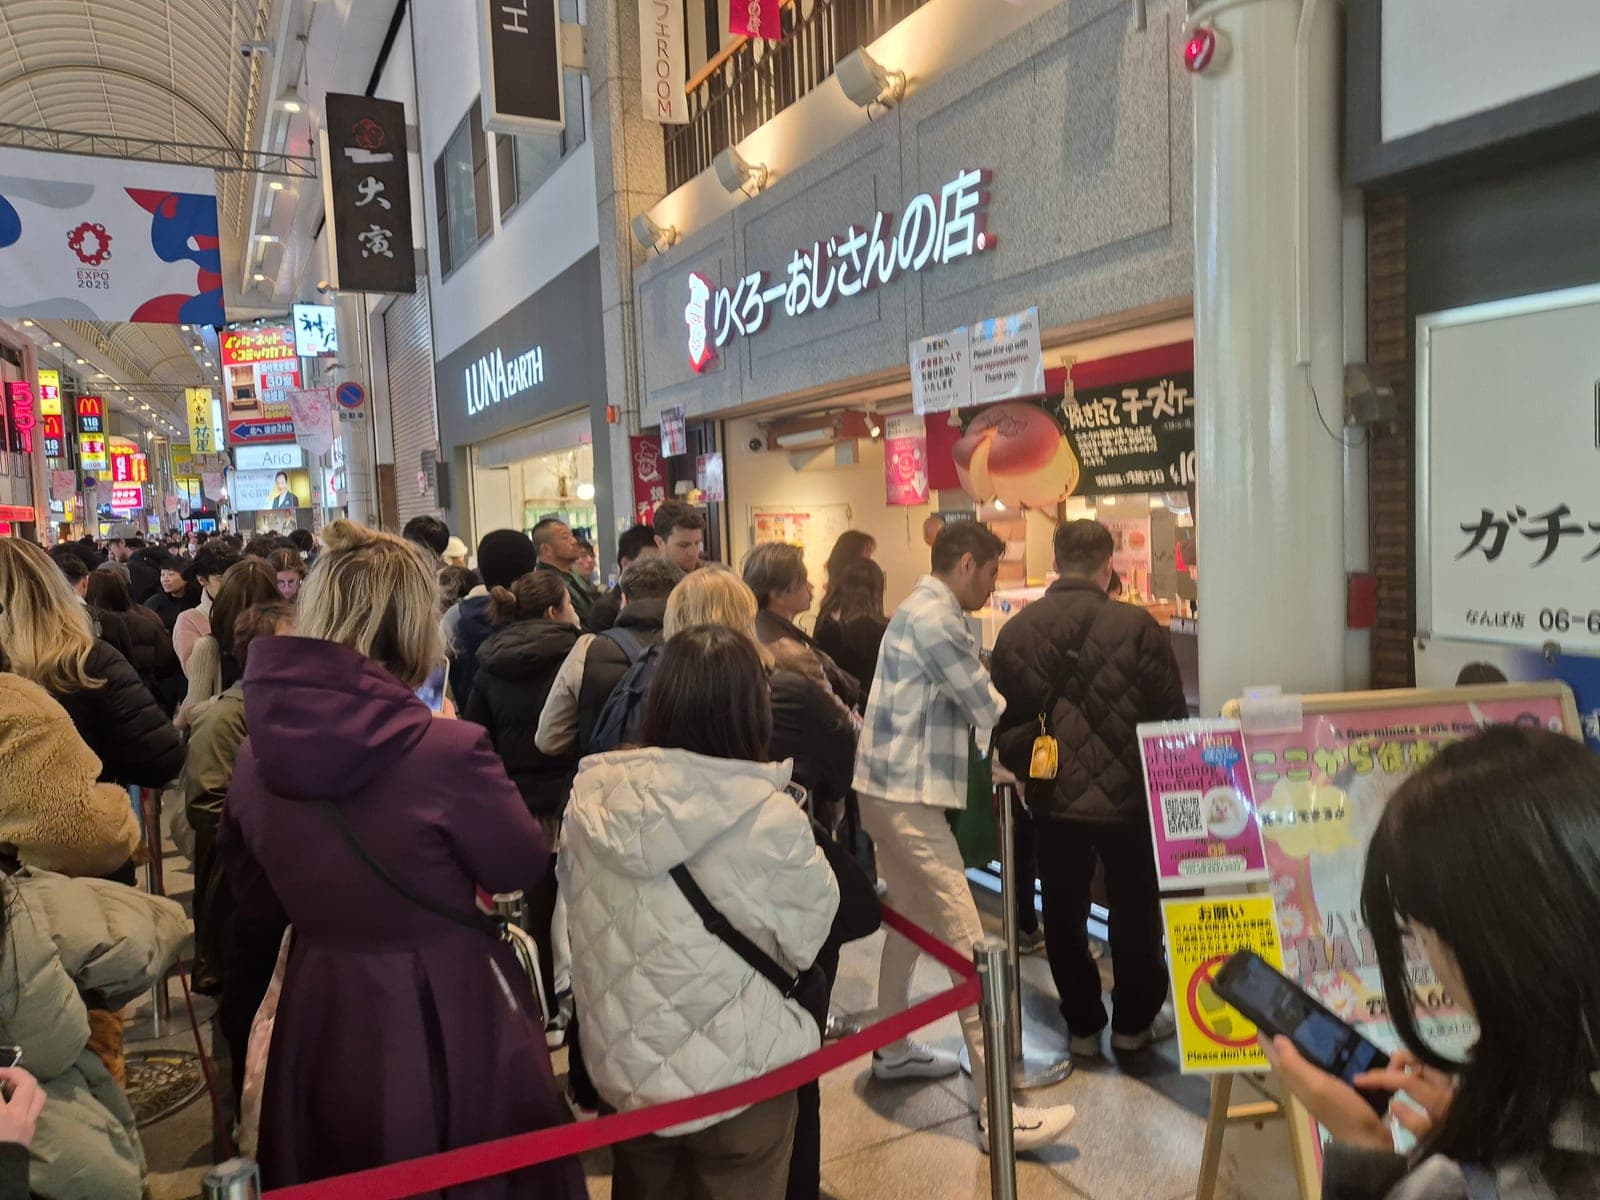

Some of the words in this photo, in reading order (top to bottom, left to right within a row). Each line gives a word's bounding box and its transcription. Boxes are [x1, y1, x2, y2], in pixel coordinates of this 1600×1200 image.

[77, 270, 110, 281] EXPO
[78, 280, 110, 290] 2025
[465, 347, 508, 416] LUNA
[507, 345, 544, 396] EARTH
[44, 439, 60, 450] 18
[262, 451, 293, 467] Aria
[1465, 608, 1526, 629] なんば店
[1199, 904, 1245, 921] お願い
[1187, 1048, 1219, 1062] Please
